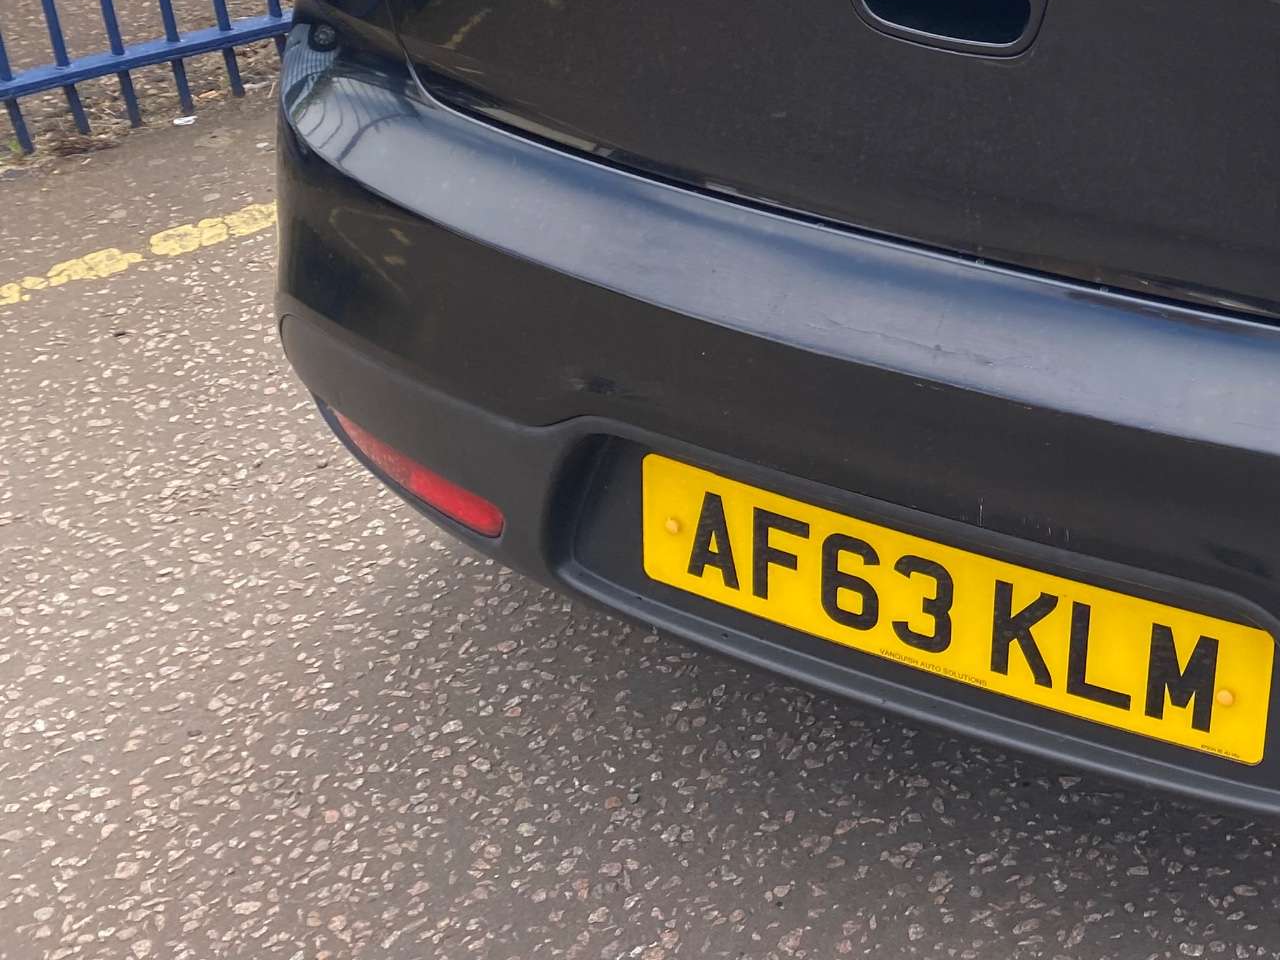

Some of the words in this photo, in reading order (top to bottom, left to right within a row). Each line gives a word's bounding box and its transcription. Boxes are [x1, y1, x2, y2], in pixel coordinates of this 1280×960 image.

[687, 491, 954, 653] AF63
[990, 579, 1220, 733] KLM
[879, 648, 919, 665] VANQUISH
[920, 661, 942, 673] AUTO
[943, 667, 988, 687] SOLUTIONS
